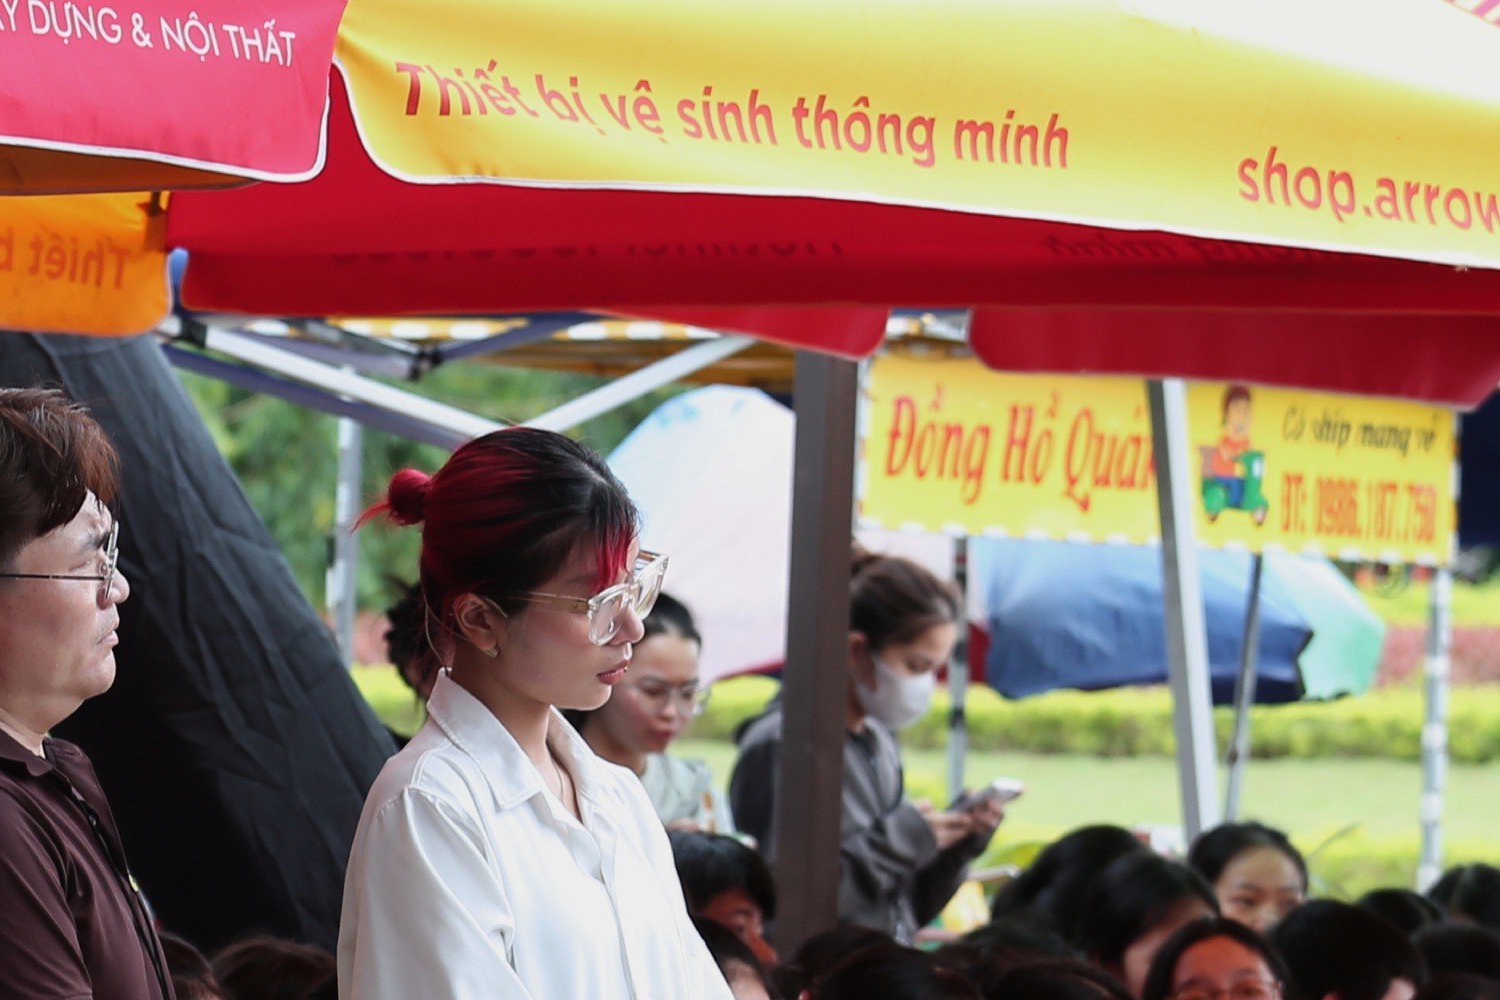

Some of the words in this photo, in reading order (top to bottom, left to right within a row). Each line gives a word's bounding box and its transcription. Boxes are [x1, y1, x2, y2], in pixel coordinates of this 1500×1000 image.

[28, 0, 122, 45] DỰNG
[131, 12, 153, 48] &
[160, 11, 220, 62] NỘI
[222, 18, 296, 67] THẤT
[395, 59, 539, 118] Thiết
[535, 74, 607, 135] bị
[599, 79, 668, 144] vệ
[677, 86, 779, 146] sinh
[792, 94, 936, 168] thông
[953, 109, 1068, 169] minh
